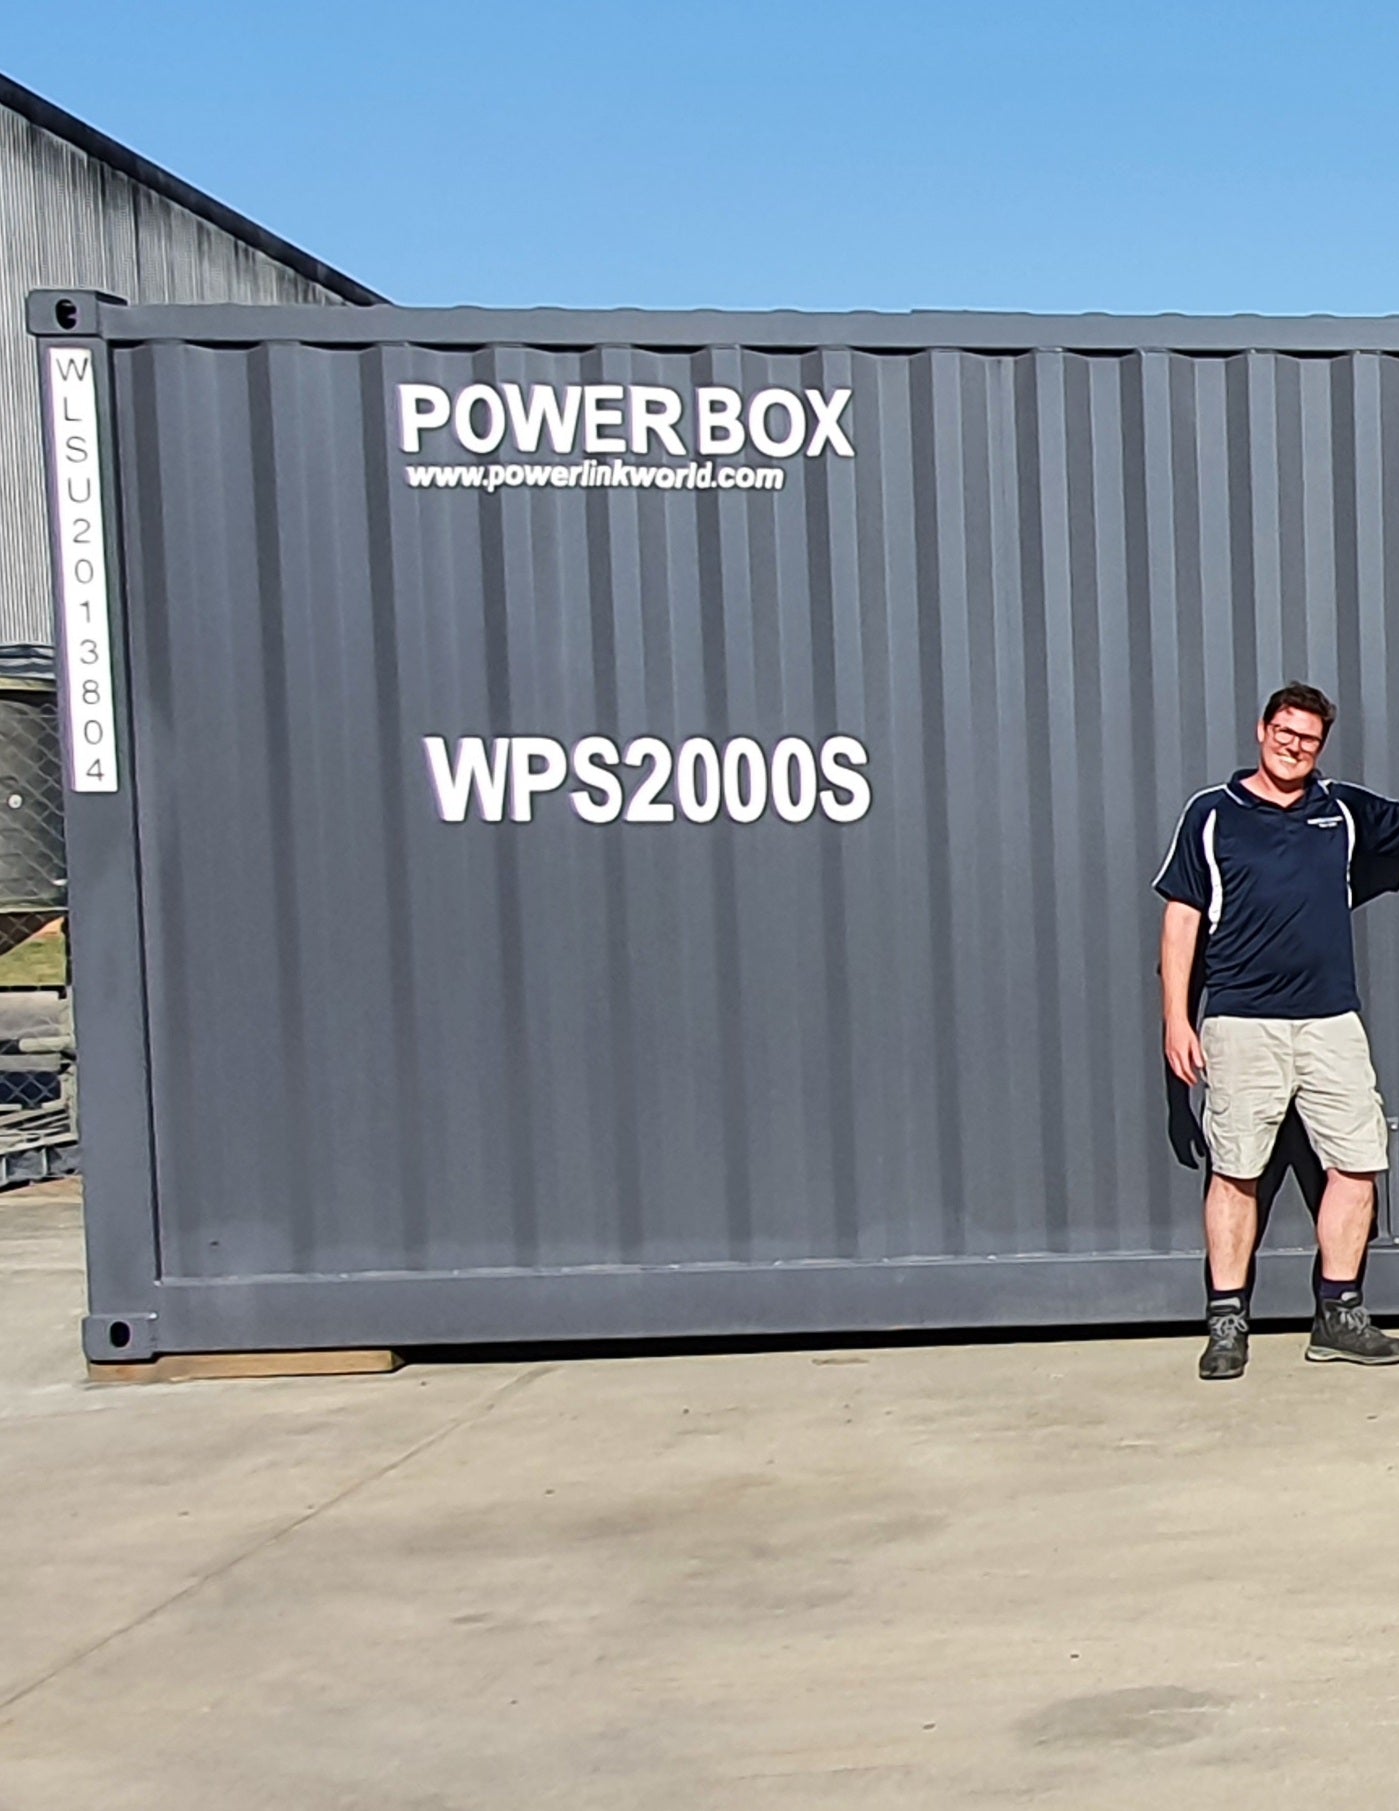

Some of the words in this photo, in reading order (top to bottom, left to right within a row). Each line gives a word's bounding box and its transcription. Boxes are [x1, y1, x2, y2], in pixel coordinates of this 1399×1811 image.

[398, 383, 687, 455] POWER
[696, 386, 856, 458] BOX
[406, 460, 785, 493] www.powerlinkworld.com
[422, 735, 872, 824] WPS2000S
